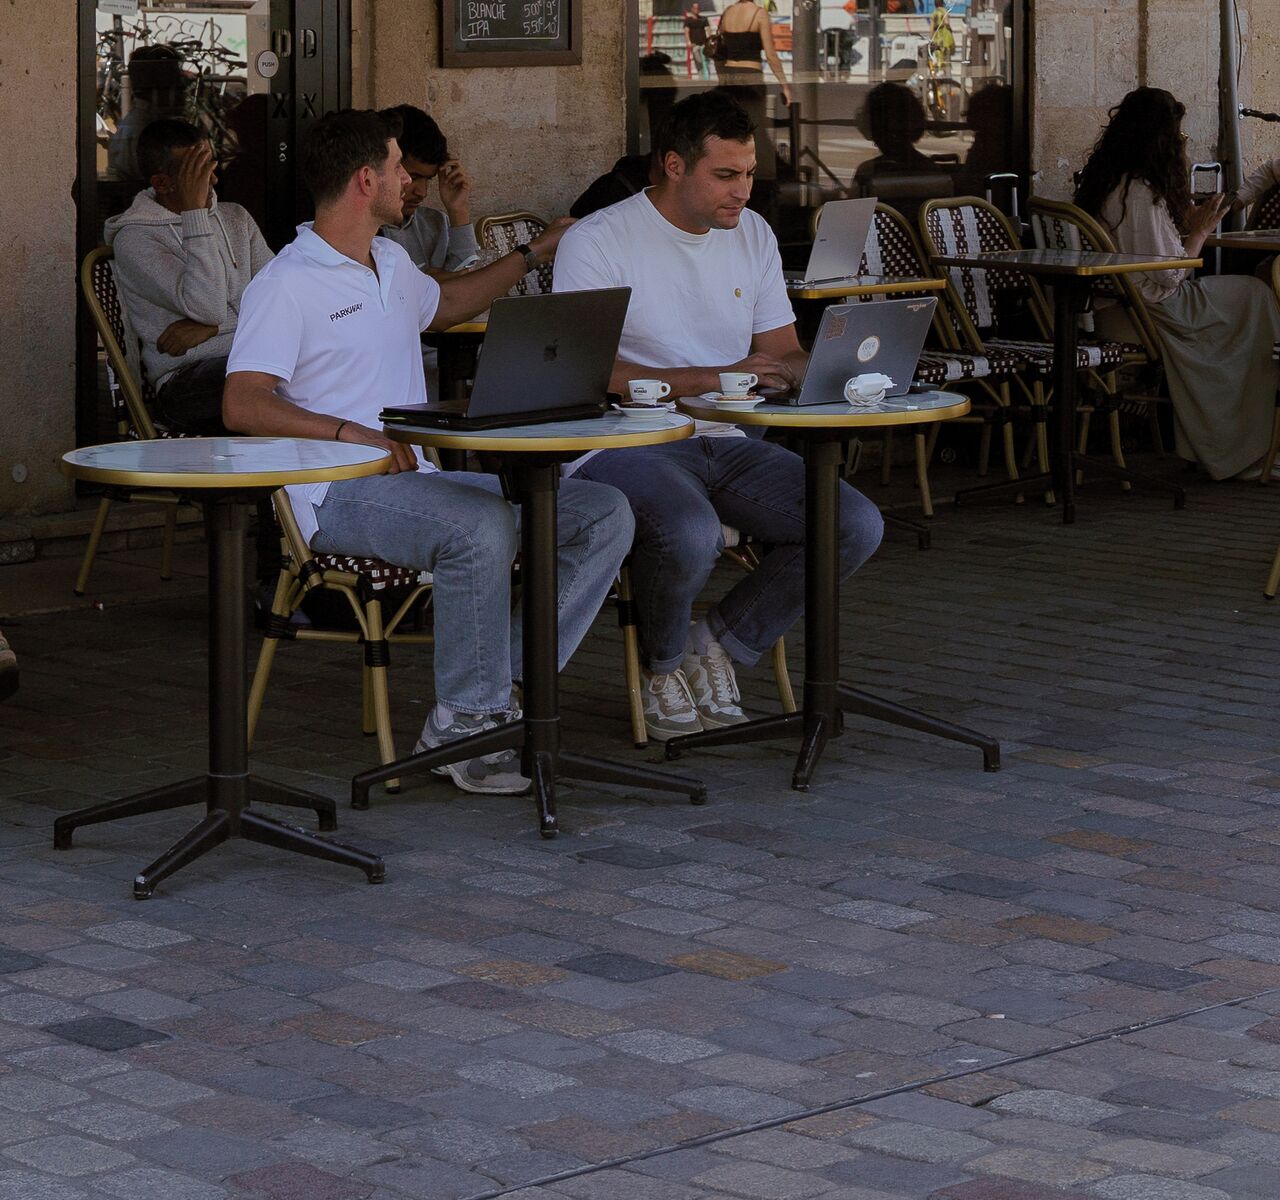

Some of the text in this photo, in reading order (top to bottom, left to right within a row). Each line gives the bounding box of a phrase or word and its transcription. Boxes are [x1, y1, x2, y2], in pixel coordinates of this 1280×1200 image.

[467, 1, 507, 21] BLANCHE
[467, 19, 491, 38] IPA
[329, 302, 364, 322] PARKWAY
